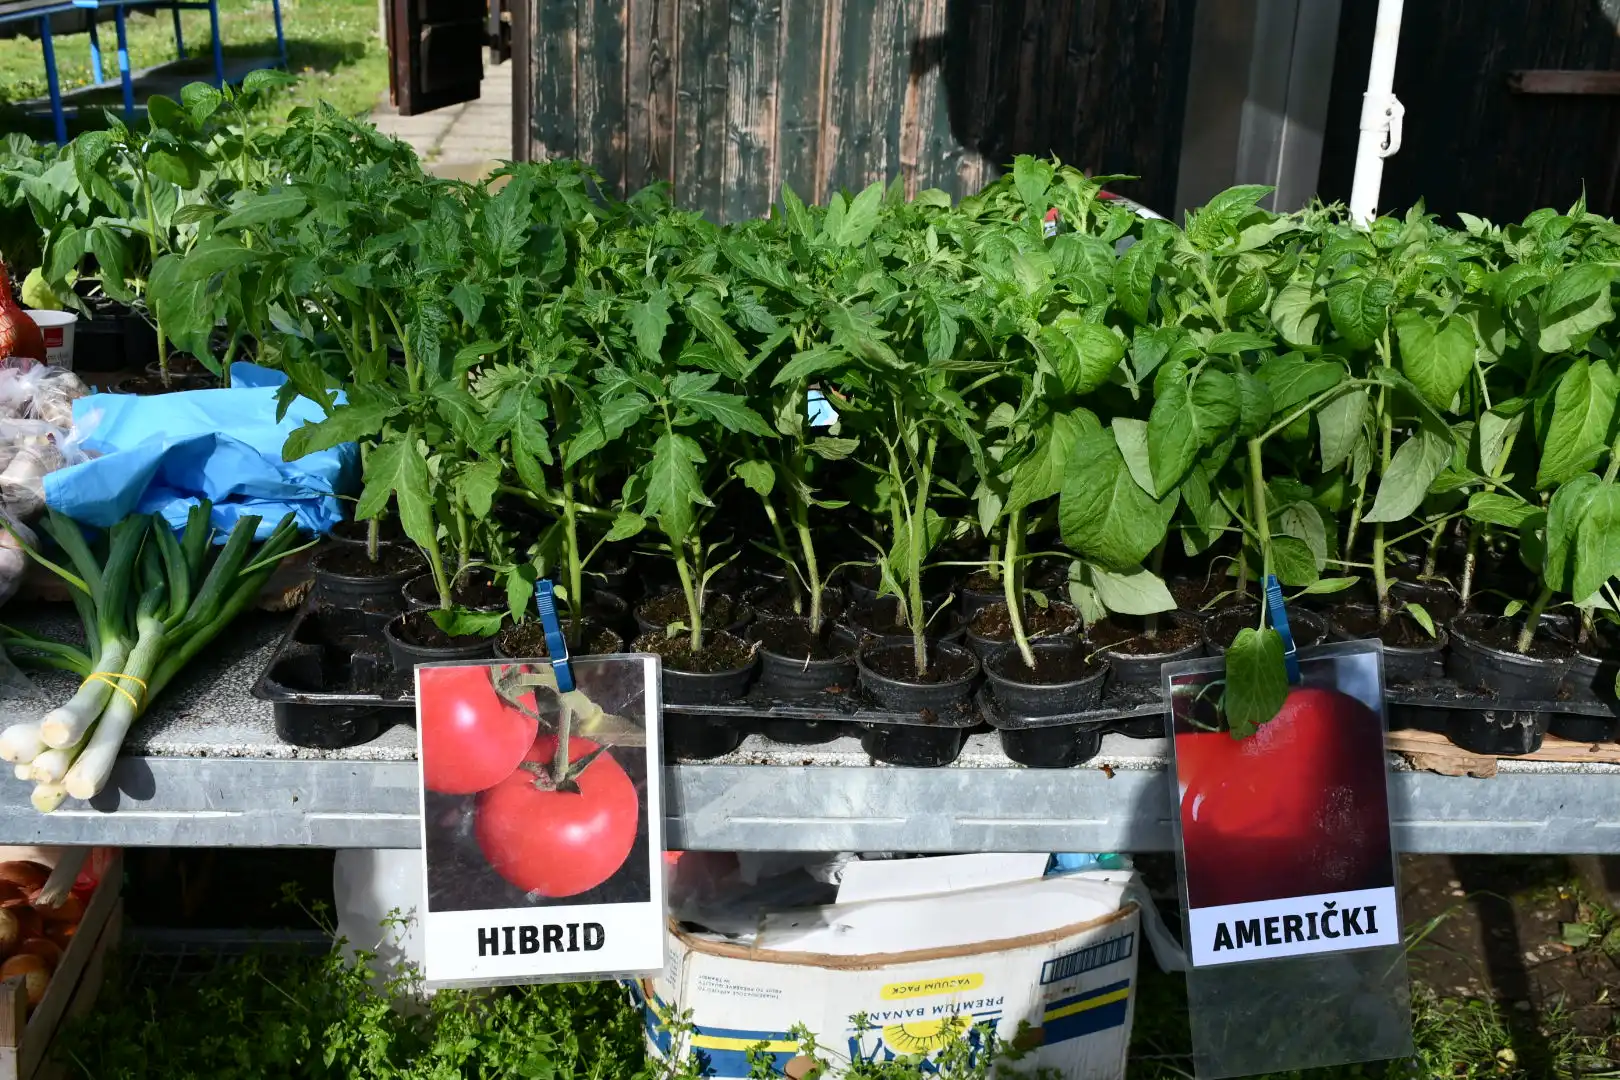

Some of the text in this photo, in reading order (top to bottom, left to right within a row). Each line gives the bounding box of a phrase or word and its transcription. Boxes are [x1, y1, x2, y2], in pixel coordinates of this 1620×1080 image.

[477, 922, 606, 957] HIBRID
[1213, 900, 1379, 951] AMERIČKI
[891, 978, 970, 995] VACUUM PACK
[848, 996, 1004, 1022] PREMIUM BANANS
